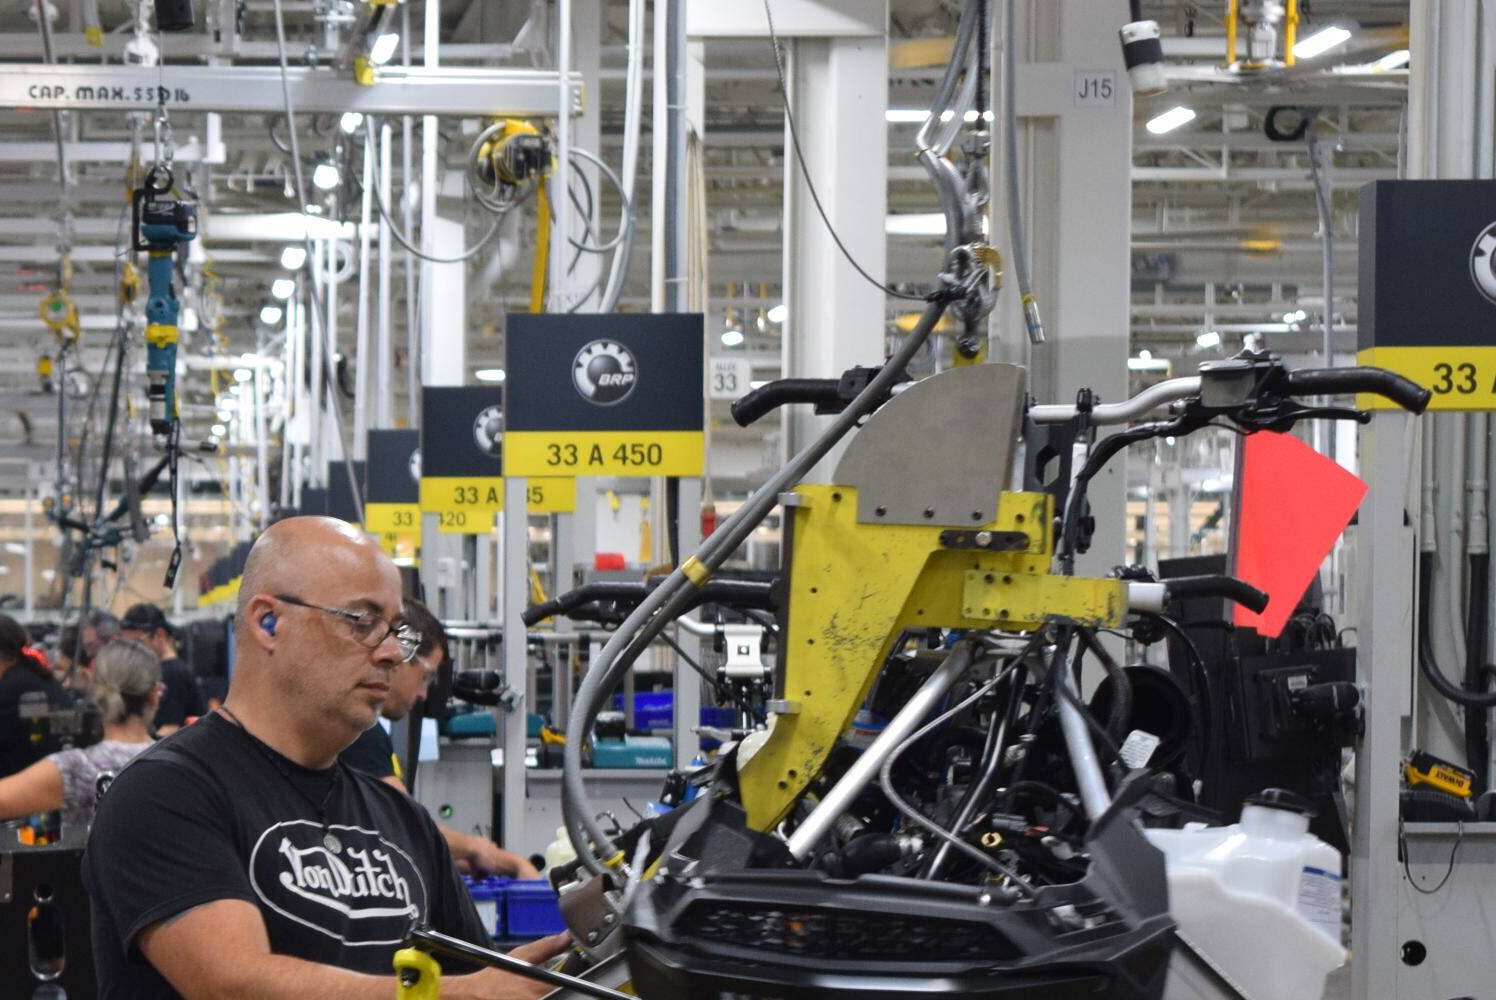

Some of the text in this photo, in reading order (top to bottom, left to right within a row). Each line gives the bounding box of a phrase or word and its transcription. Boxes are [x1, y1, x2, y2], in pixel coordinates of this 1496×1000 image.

[28, 85, 70, 99] CAP.
[1078, 78, 1112, 99] J15
[598, 373, 634, 386] BRP
[714, 373, 736, 391] 33
[1432, 363, 1477, 394] 33
[547, 443, 662, 466] 33 A 450
[454, 486, 478, 504] 33
[486, 486, 499, 504] A
[393, 511, 413, 526] 33
